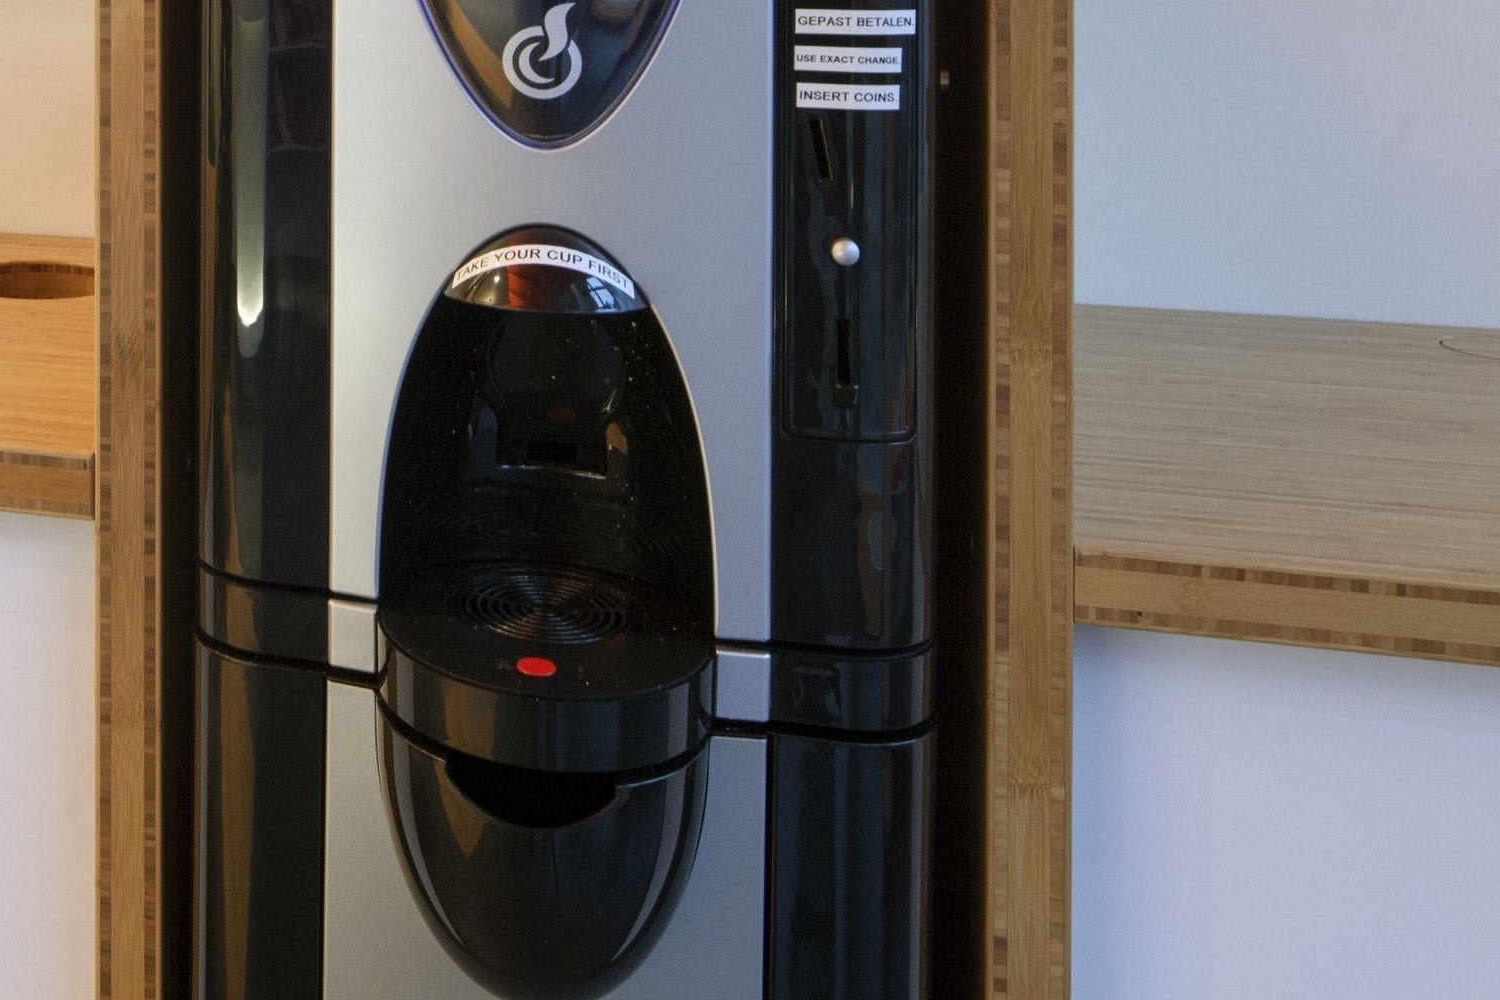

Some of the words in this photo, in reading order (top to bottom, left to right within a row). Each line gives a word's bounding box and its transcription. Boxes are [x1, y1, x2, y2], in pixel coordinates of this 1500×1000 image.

[797, 15, 853, 27] GEPAST
[796, 54, 817, 63] USE
[820, 55, 855, 64] EXACT
[857, 56, 900, 65] CHANGE.
[799, 90, 850, 102] INSERT
[854, 92, 897, 102] COINS.
[456, 257, 489, 281] TAKE
[494, 248, 541, 262] YOUR
[547, 249, 583, 265] CUP
[588, 259, 629, 289] FIRST
